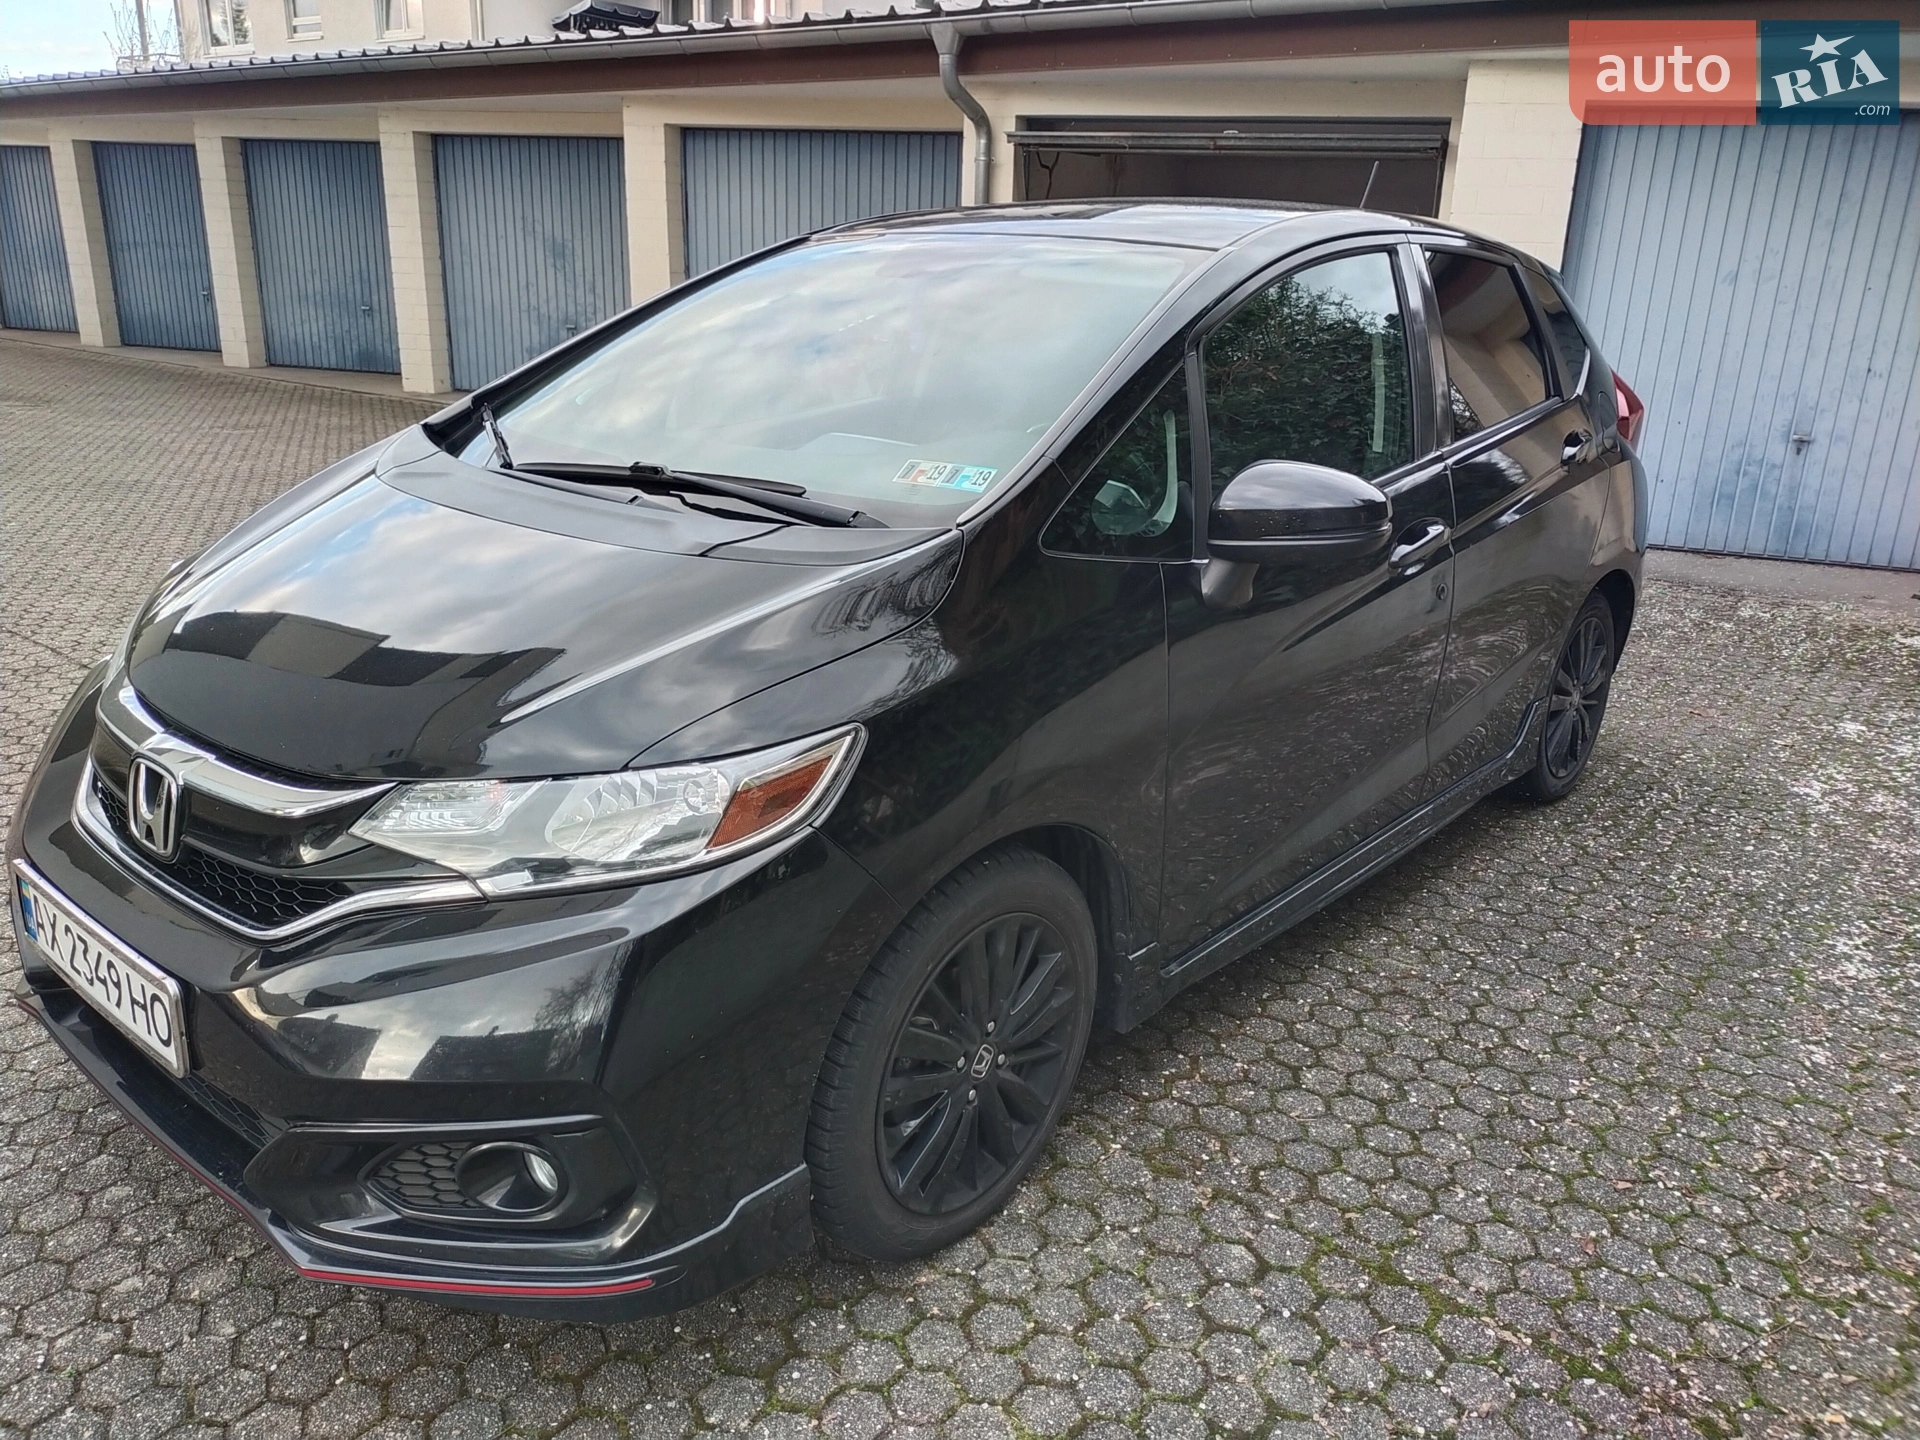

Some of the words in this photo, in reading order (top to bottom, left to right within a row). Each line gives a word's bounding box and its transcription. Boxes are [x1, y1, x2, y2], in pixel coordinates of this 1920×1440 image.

[926, 464, 948, 481] 19
[970, 470, 993, 487] 19
[33, 893, 65, 963] AX
[64, 923, 122, 1010] 2349
[125, 971, 172, 1048] HO
